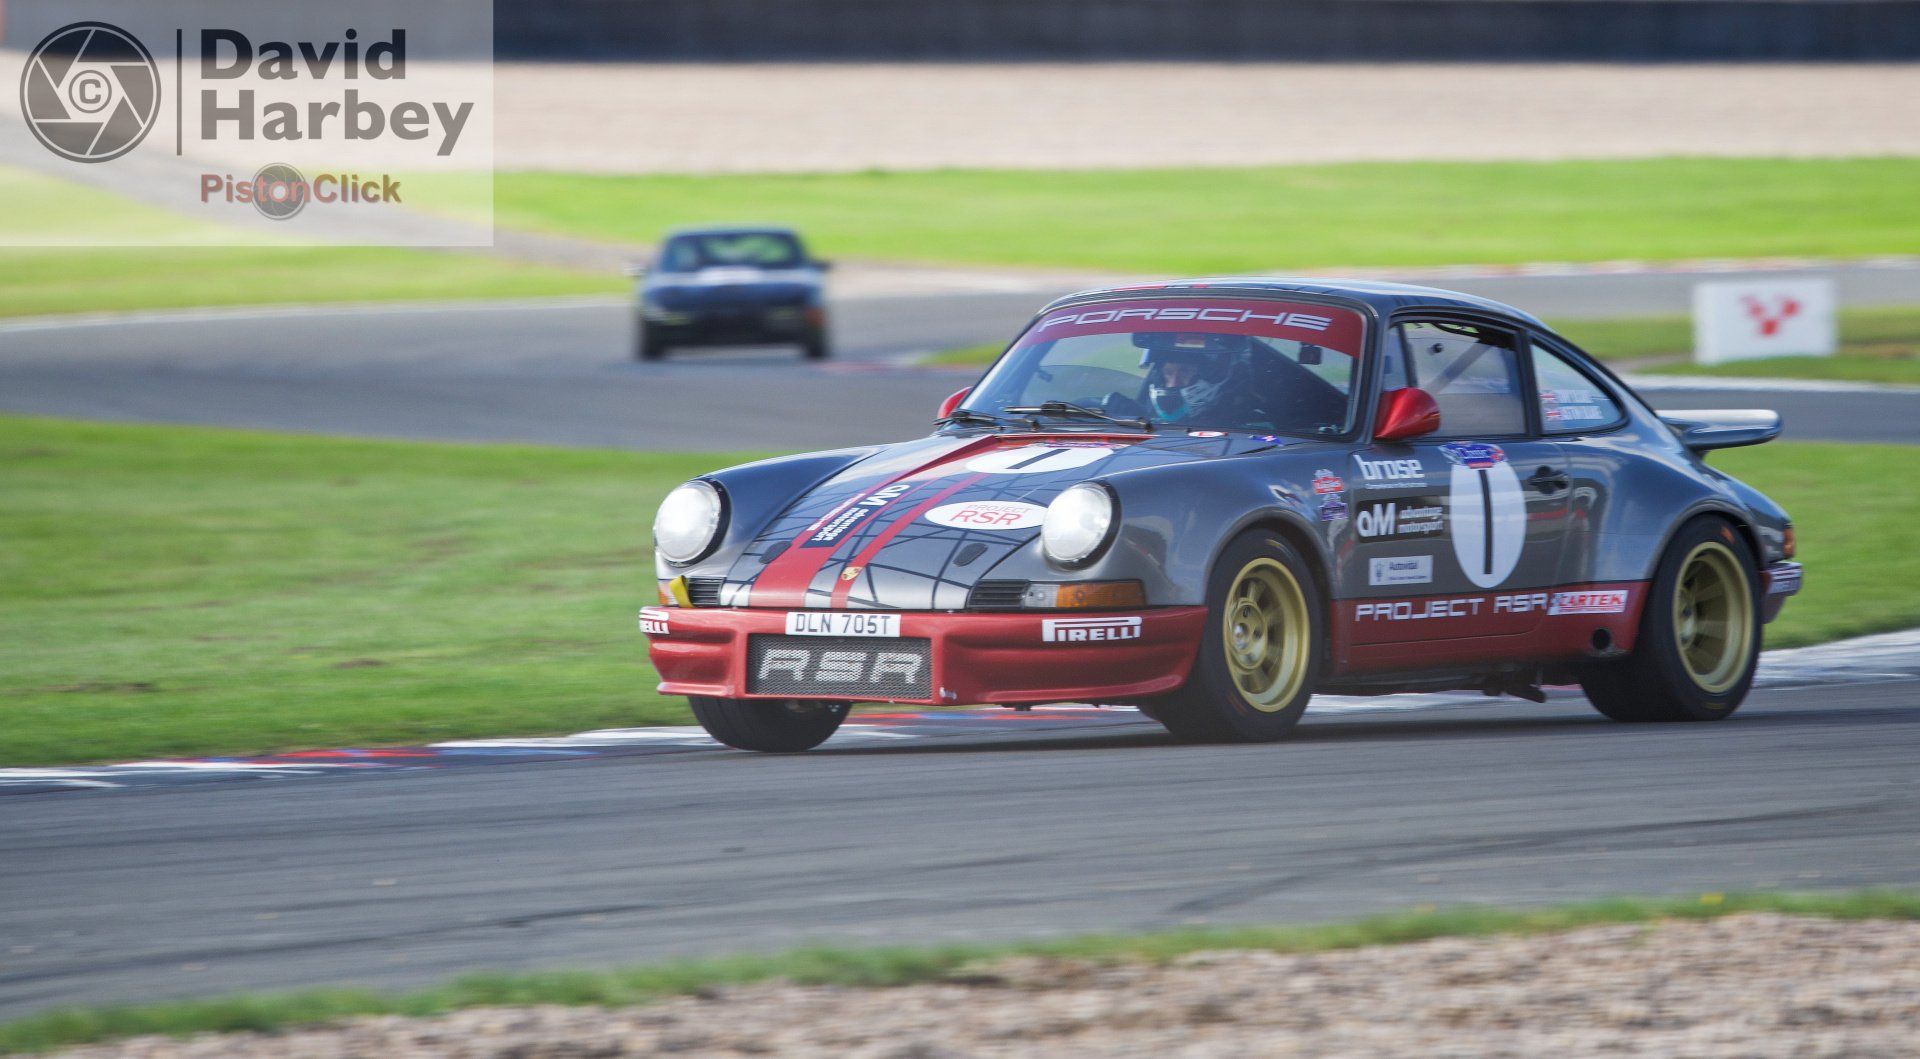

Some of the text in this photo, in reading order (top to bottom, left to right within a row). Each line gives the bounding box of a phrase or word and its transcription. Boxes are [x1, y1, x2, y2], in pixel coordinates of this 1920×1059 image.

[1038, 307, 1333, 332] PORSCHE
[1353, 454, 1425, 480] brose
[950, 510, 1023, 526] RSR
[967, 503, 1031, 513] PROJECT
[1478, 469, 1493, 574] 1
[1355, 592, 1548, 622] PROJECT RSR
[795, 613, 891, 635] DLN 705T
[1042, 616, 1142, 642] PIRELLI
[758, 648, 923, 684] RSR
